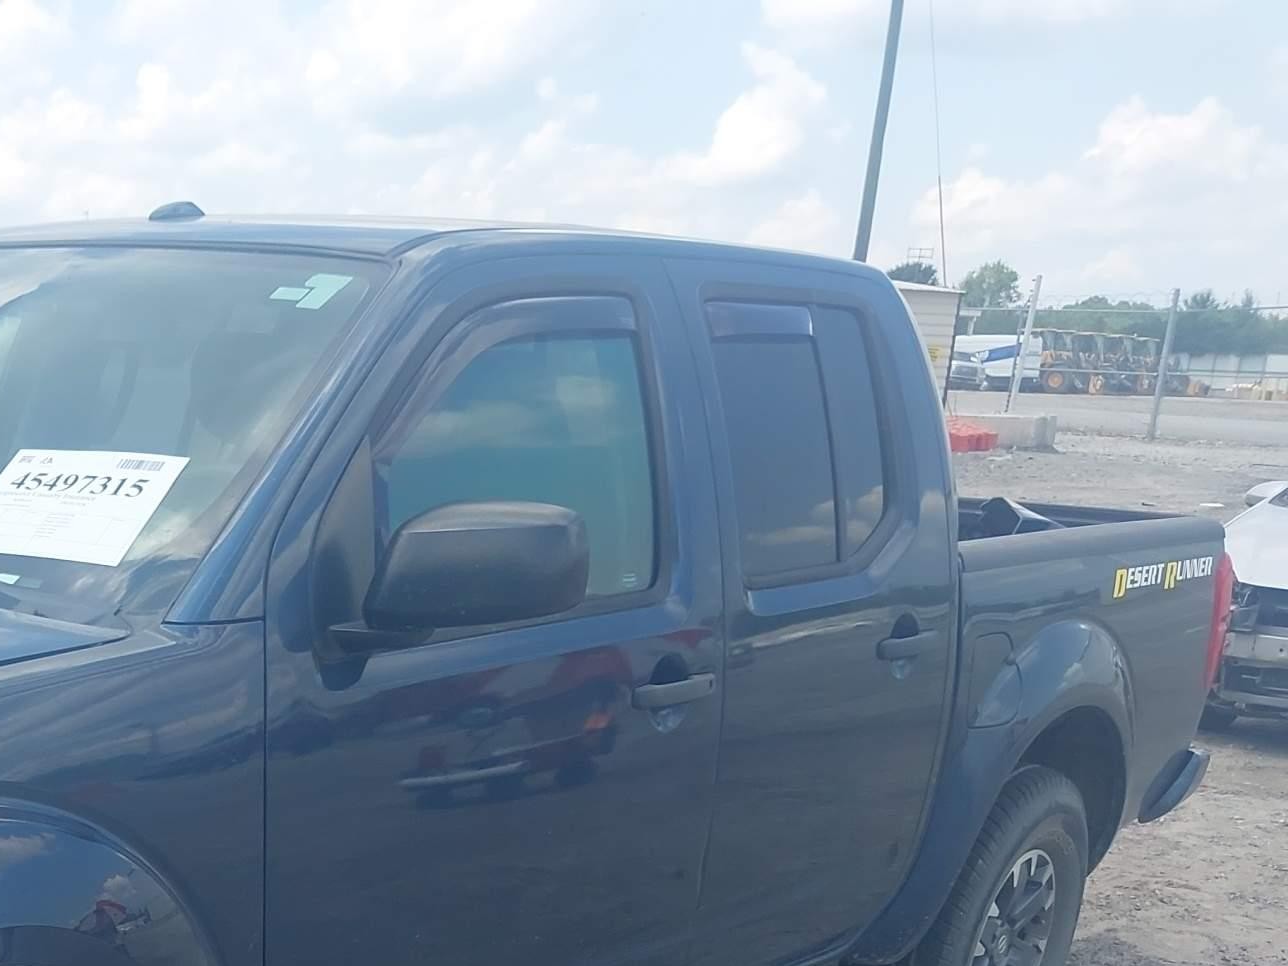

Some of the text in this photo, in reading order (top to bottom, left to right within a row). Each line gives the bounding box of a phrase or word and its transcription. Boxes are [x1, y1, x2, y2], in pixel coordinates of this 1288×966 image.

[10, 471, 150, 498] 45497315
[1113, 556, 1213, 598] DESERT RUNNER
